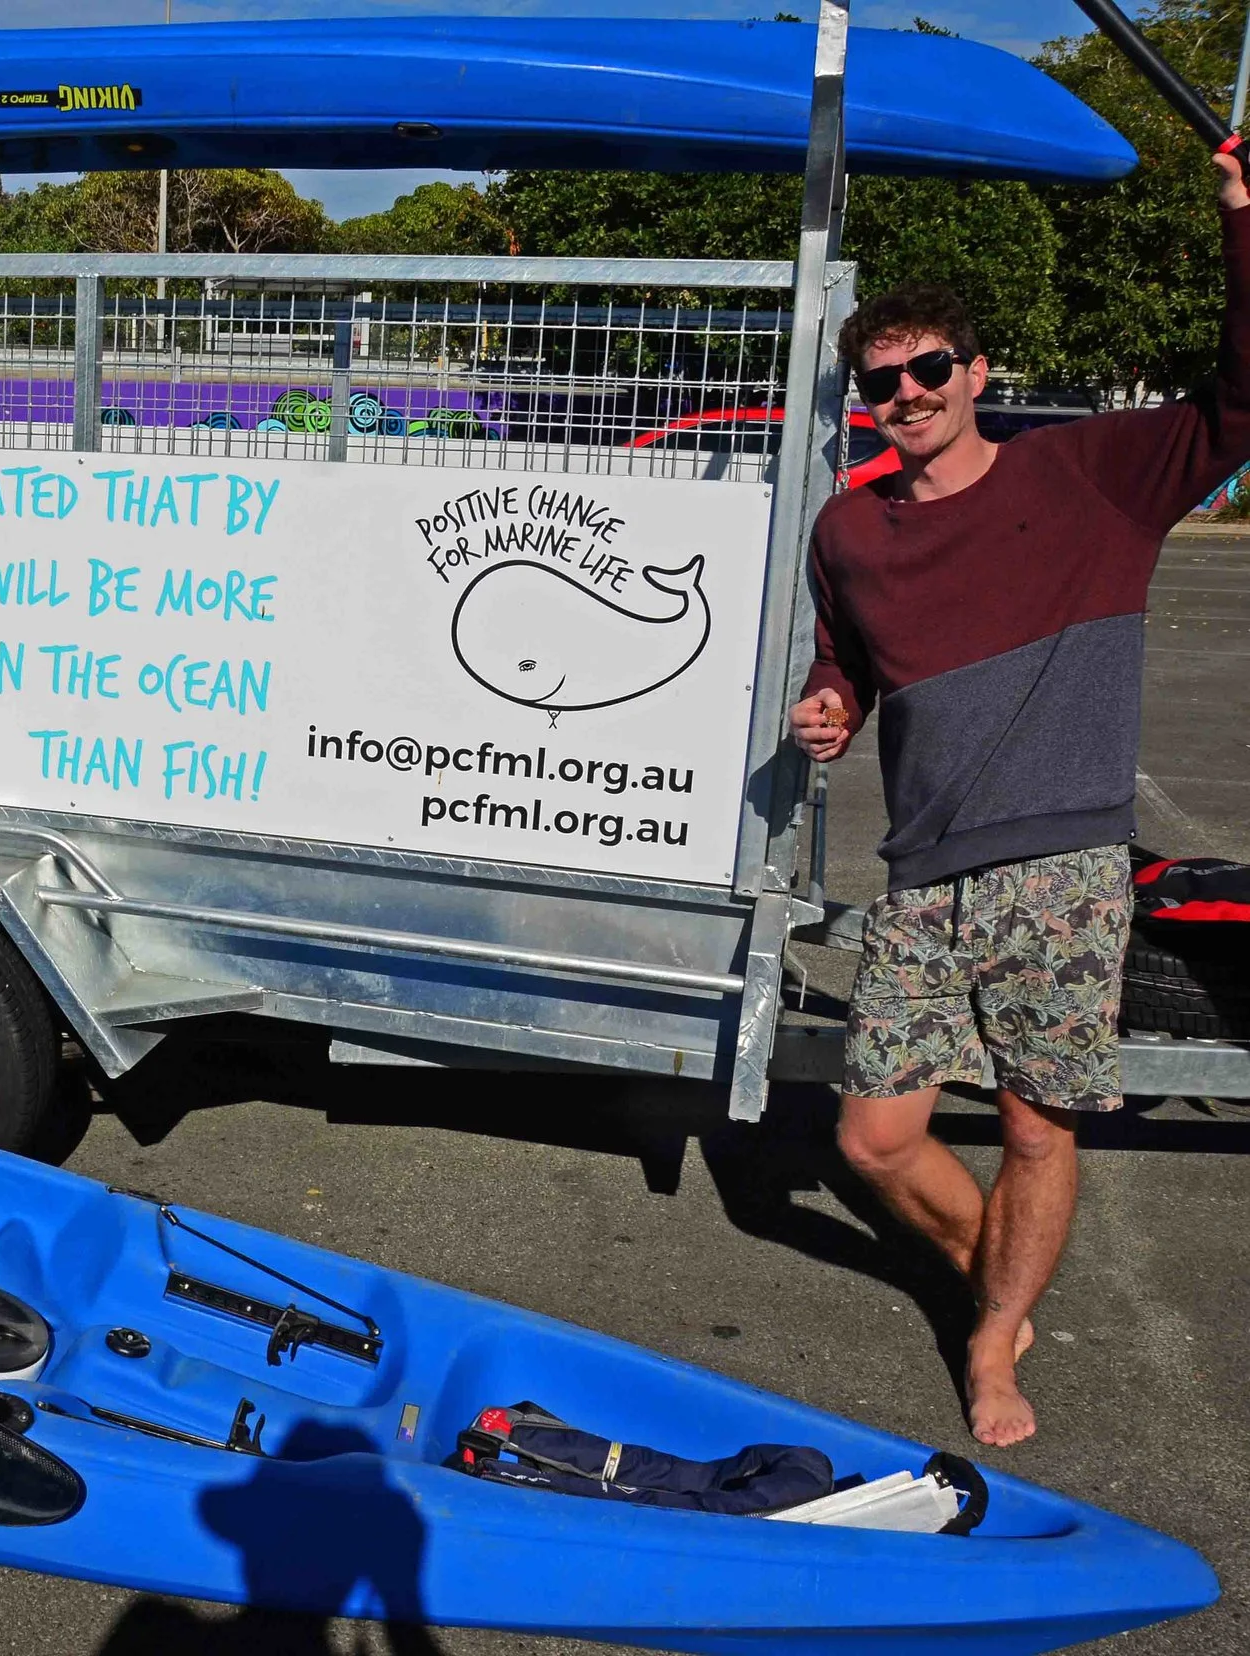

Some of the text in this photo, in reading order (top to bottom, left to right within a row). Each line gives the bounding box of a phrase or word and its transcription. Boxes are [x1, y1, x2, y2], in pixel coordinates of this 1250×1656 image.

[0, 83, 136, 112] VIKING TEMPO 2
[92, 469, 220, 528] THAT
[225, 473, 281, 536] BY
[415, 484, 626, 546] POSITIVE CHANGE
[88, 558, 141, 618] BE
[155, 569, 279, 622] MORE
[426, 522, 635, 594] FOR MARINE LIFE
[38, 644, 122, 700] THE
[137, 653, 272, 716] OCEAN
[28, 730, 268, 802] THAN FISH!
[307, 724, 695, 796] info@pcfml.org.au
[421, 793, 690, 847] pcfml.org.au
